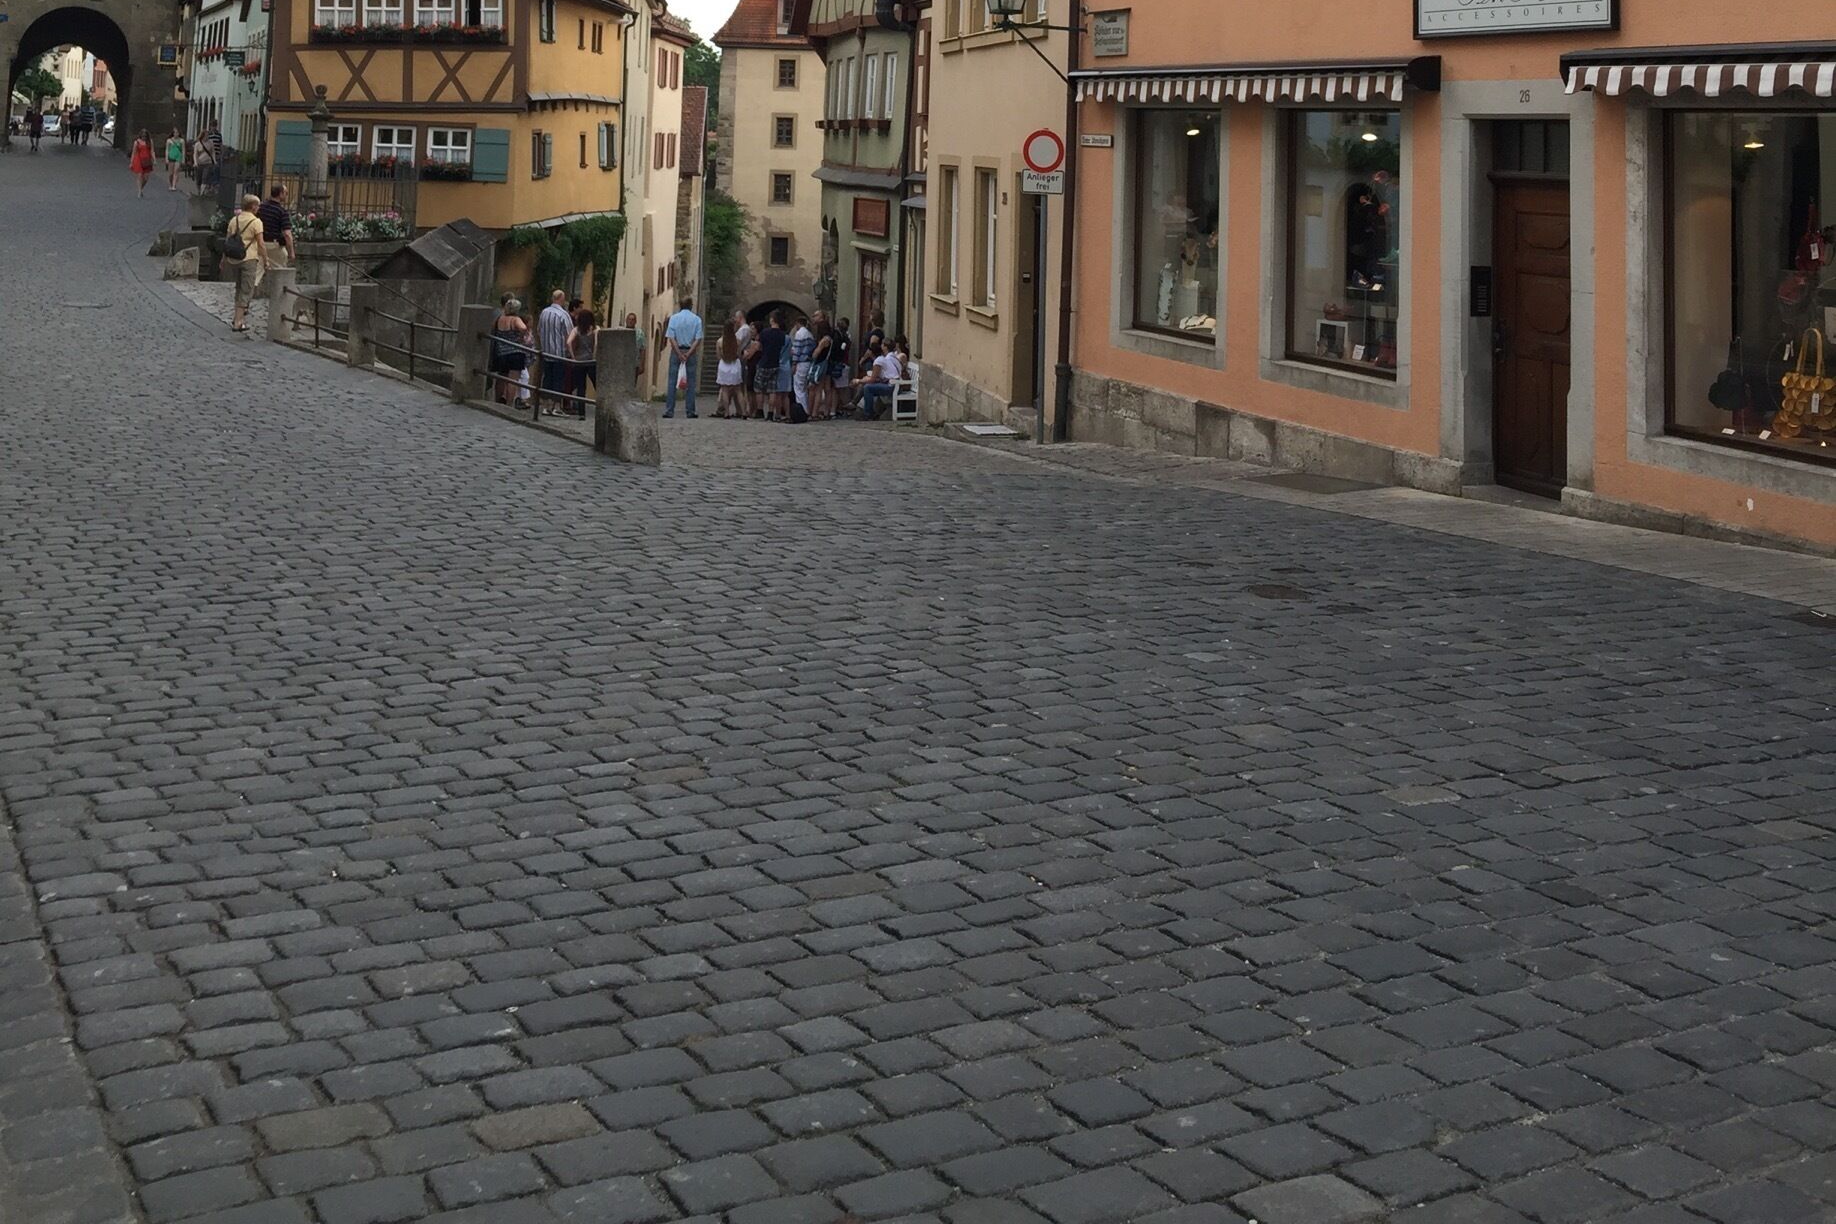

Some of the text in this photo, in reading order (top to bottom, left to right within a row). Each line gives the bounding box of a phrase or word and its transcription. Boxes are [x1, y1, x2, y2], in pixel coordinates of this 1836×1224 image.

[1427, 3, 1601, 23] ACCESSOIRES
[1519, 89, 1531, 103] 26
[1027, 173, 1060, 183] Anlieger
[1036, 182, 1050, 191] frei
